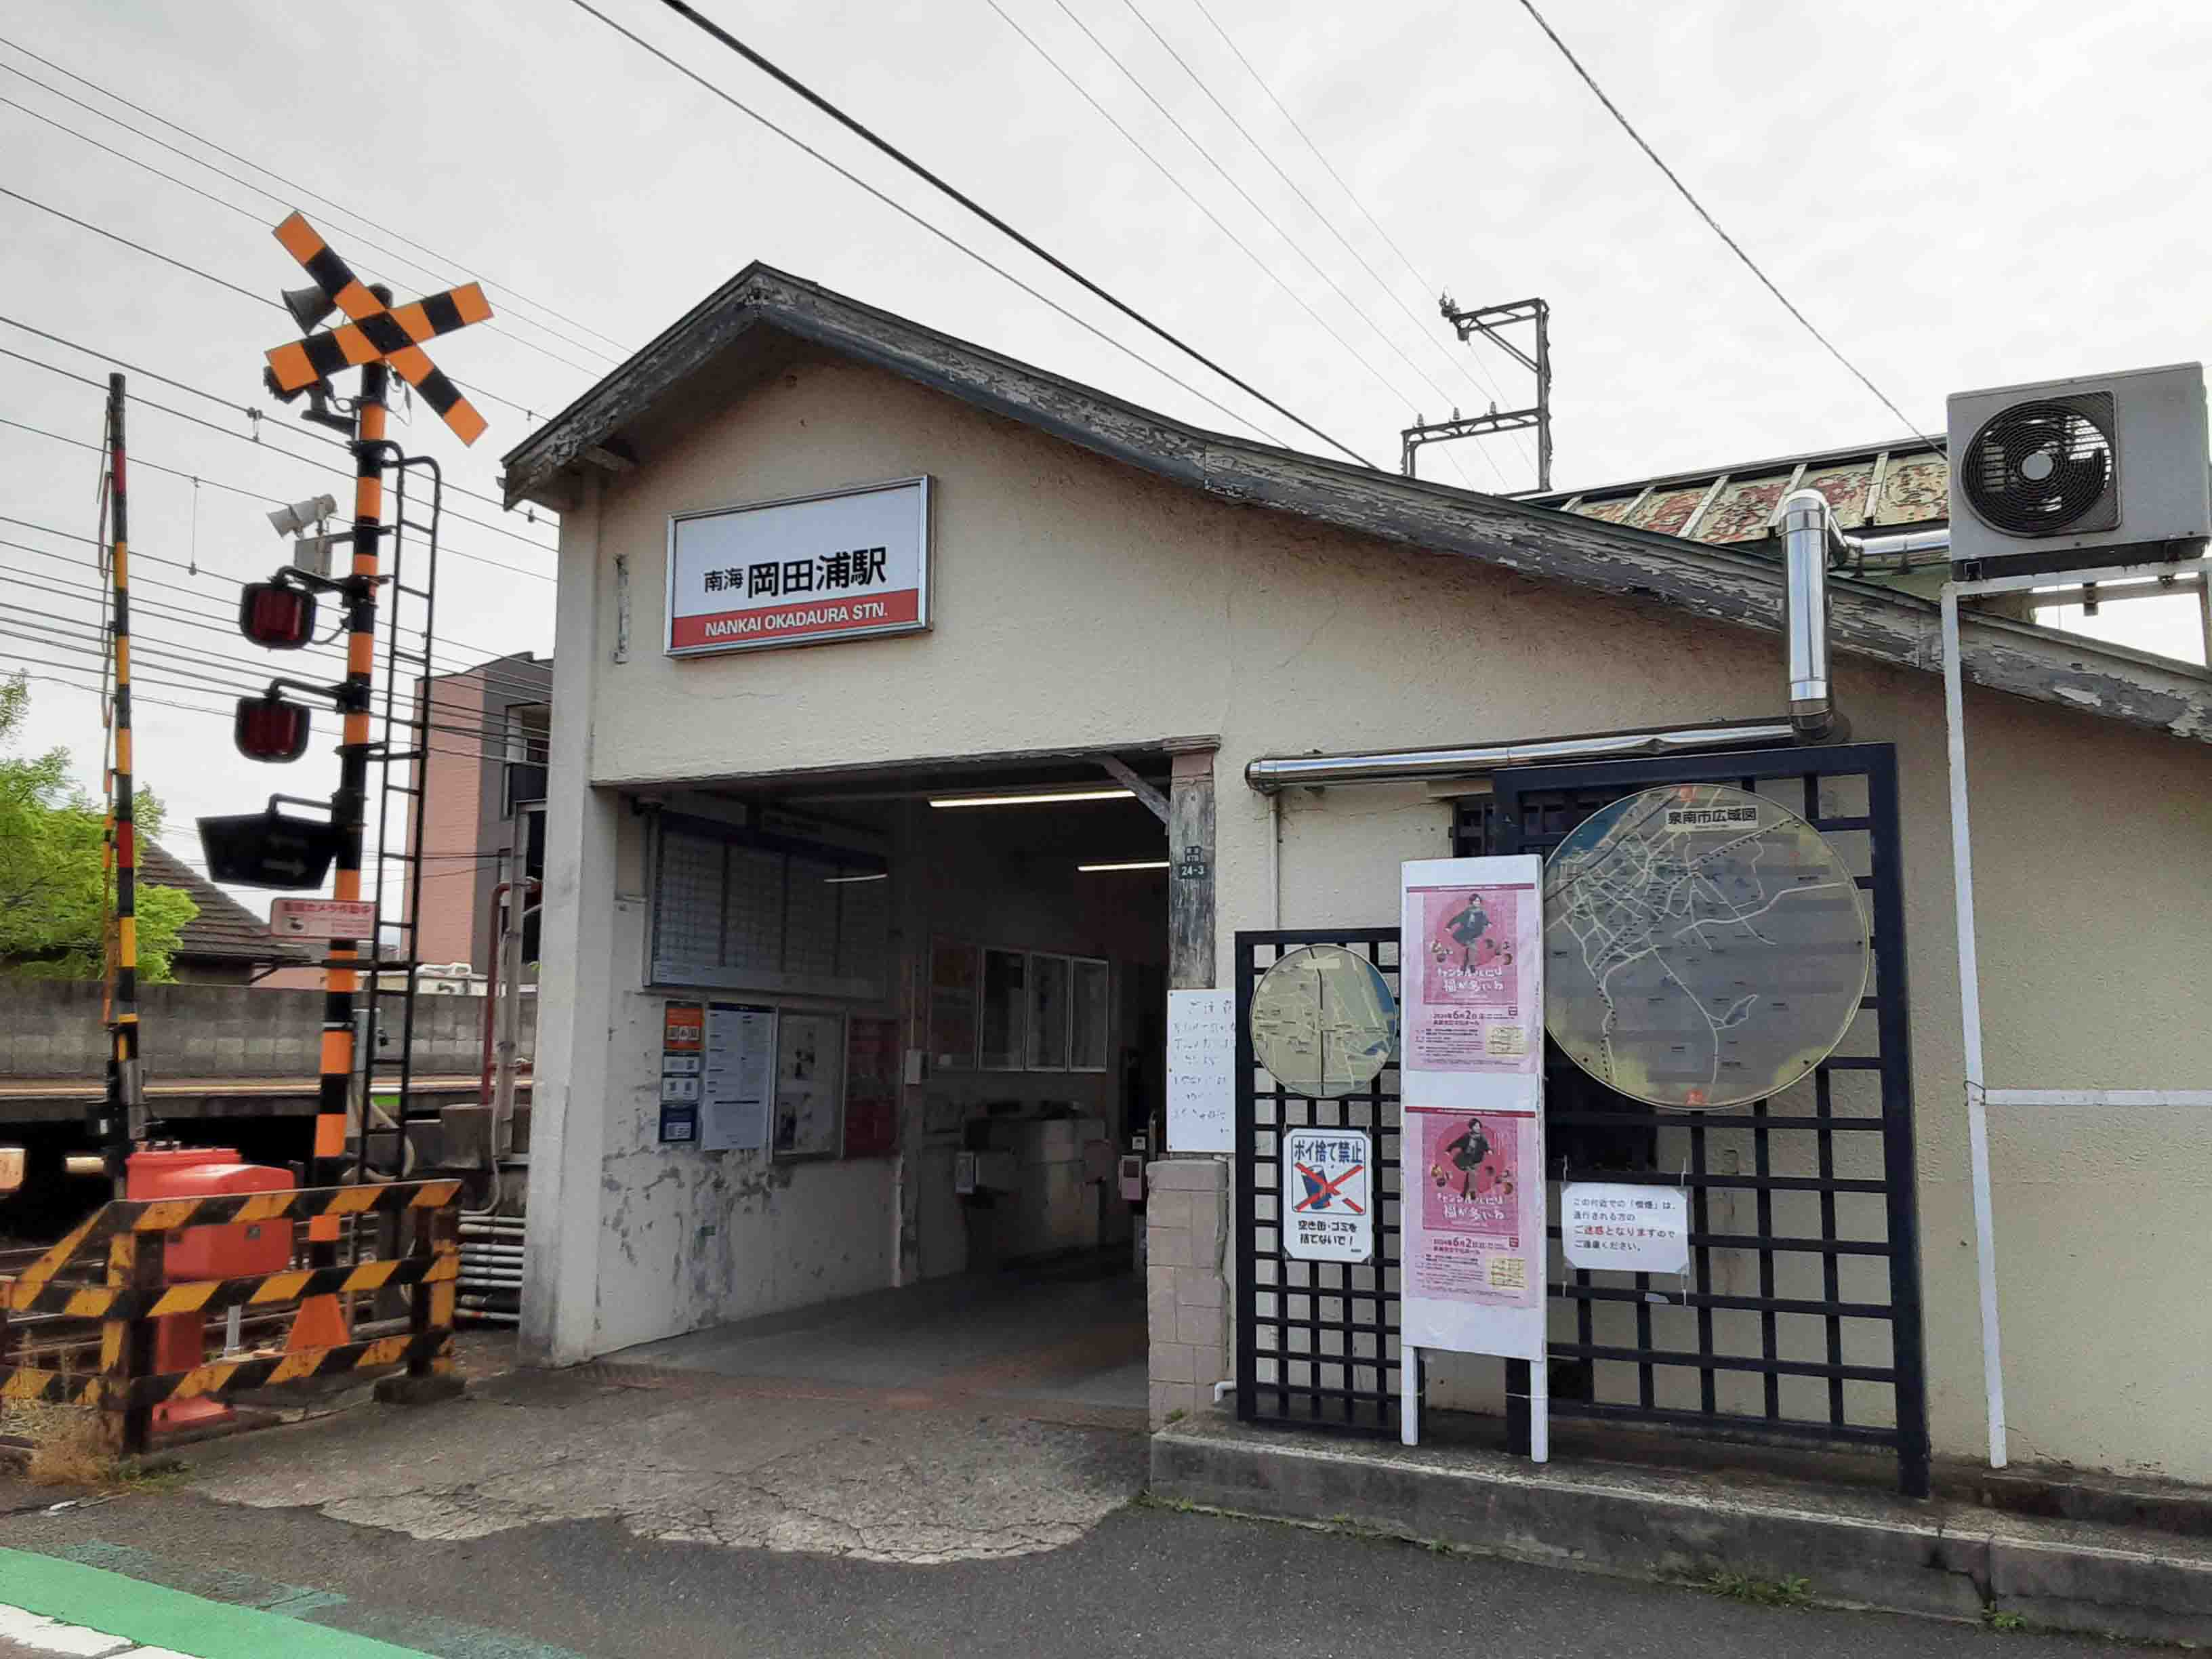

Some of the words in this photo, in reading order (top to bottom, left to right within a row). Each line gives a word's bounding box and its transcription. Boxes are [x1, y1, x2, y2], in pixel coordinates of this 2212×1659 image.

[703, 568, 743, 592] 南海
[747, 546, 887, 598] 岡田浦駅
[705, 617, 761, 636] NANKAI
[765, 606, 849, 630] OKADAURA
[853, 602, 888, 621] STN.
[1668, 807, 1757, 825] 泉南市広域図
[1181, 866, 1204, 876] 24-3
[1294, 1140, 1364, 1164] ポイ捨て禁止
